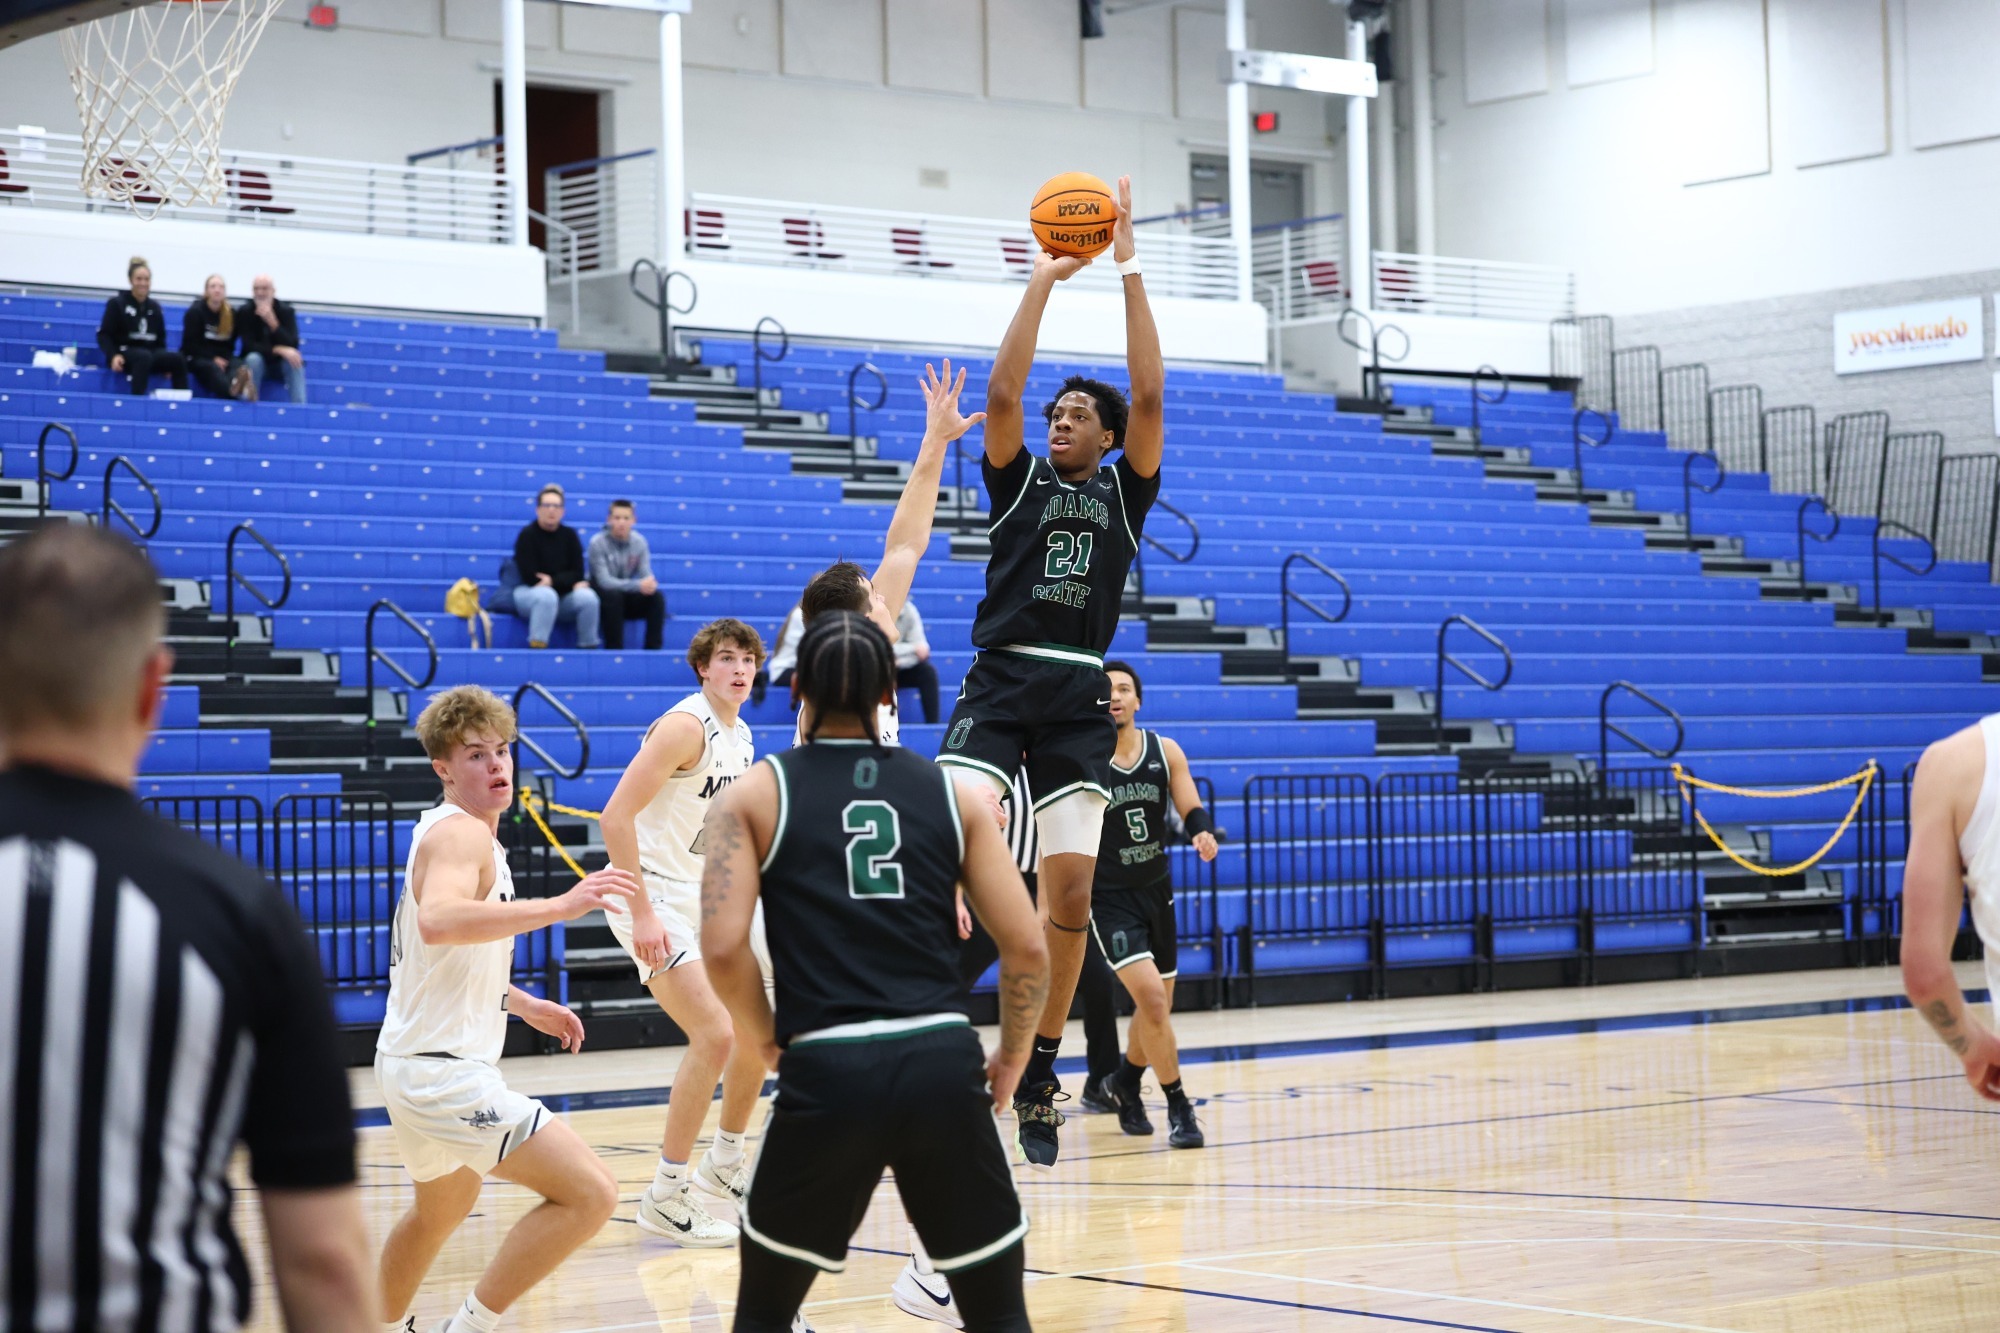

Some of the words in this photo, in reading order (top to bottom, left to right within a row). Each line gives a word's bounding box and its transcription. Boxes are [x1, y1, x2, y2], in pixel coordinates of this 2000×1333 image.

[1057, 202, 1100, 217] NCAA
[1049, 228, 1109, 248] Wilson
[1849, 314, 1969, 356] yocolorado
[1044, 530, 1093, 578] 21
[1124, 807, 1149, 842] 5
[842, 800, 905, 900] 2
